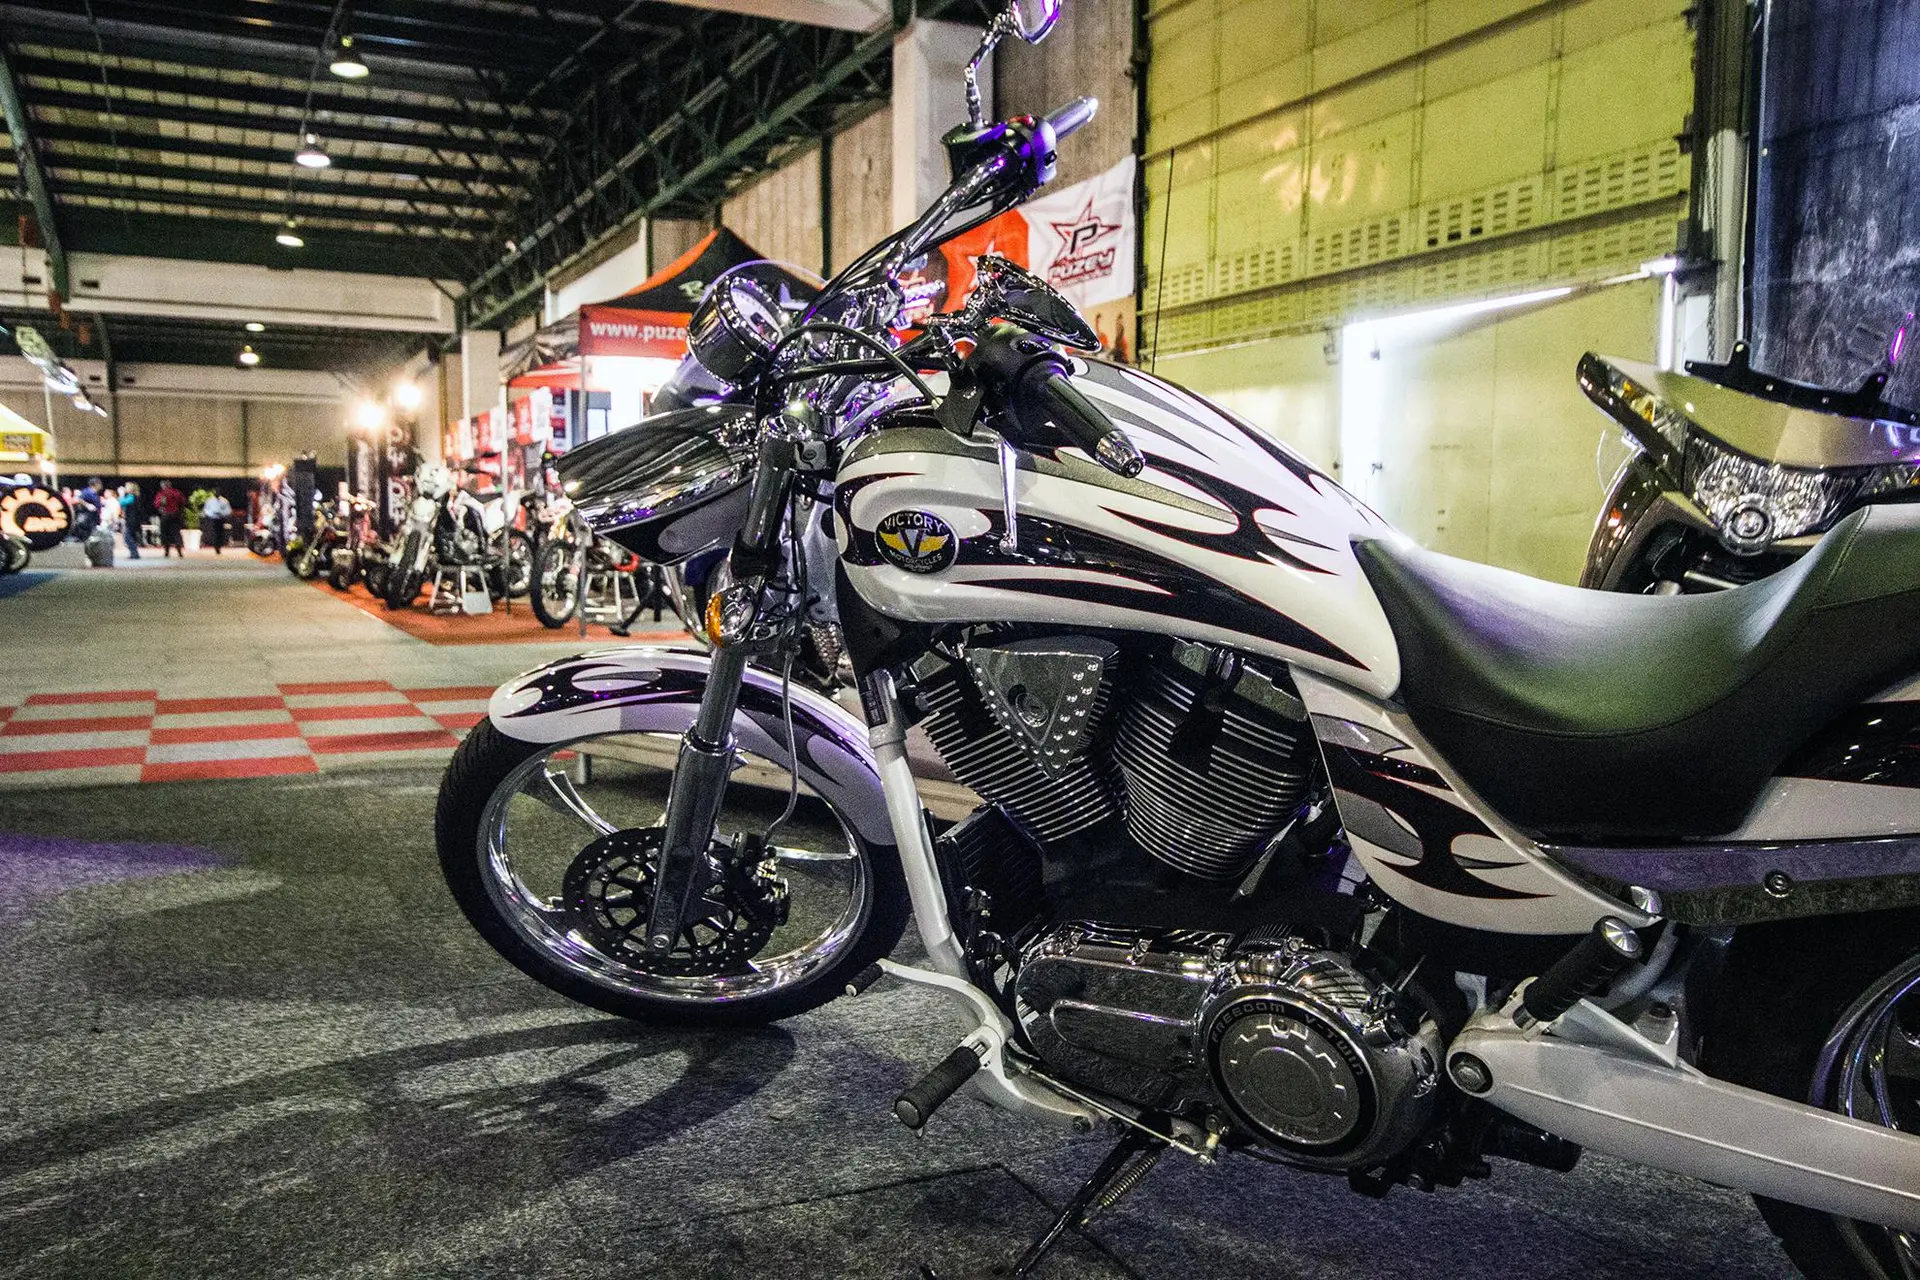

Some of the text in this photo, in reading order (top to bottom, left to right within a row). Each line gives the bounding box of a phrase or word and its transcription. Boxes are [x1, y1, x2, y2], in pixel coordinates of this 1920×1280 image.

[1047, 247, 1116, 284] PUZEY
[884, 513, 943, 533] VICTORY
[889, 549, 942, 565] MOTORCYCLES
[1211, 1001, 1286, 1043] FREEDOM
